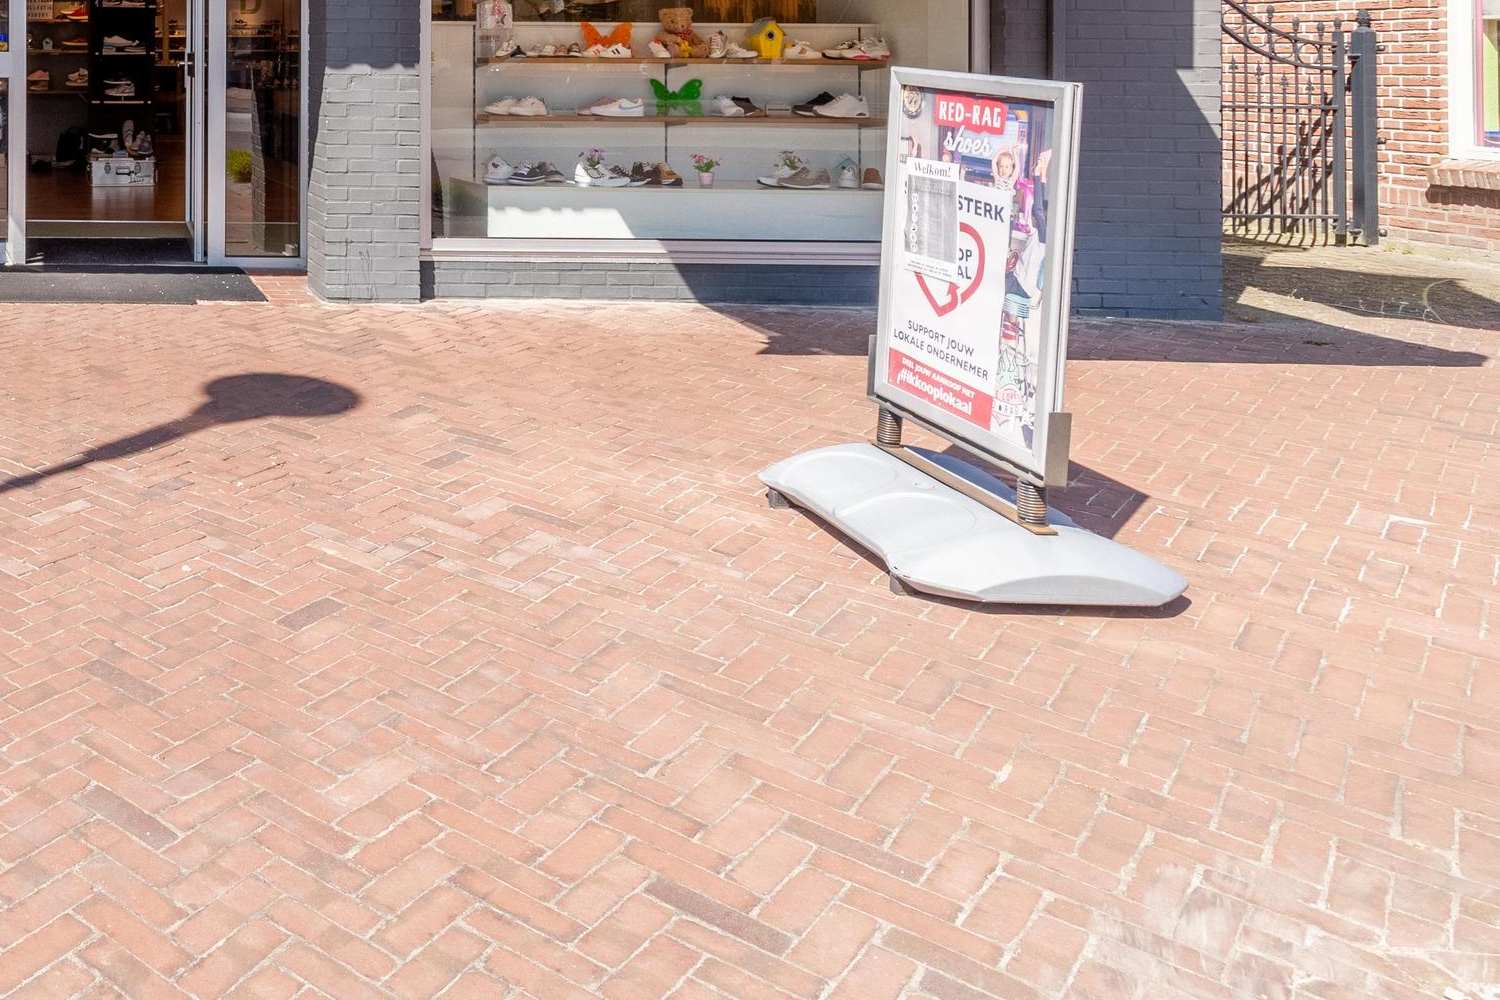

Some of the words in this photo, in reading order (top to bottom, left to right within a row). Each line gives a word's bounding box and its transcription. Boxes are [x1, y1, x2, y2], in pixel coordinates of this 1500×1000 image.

[938, 100, 1002, 129] RED-RAG
[943, 124, 994, 157] shoes
[914, 161, 951, 178] Welkom!
[893, 328, 925, 351] LOKALE
[926, 345, 989, 381] ONDERNEMER
[907, 319, 946, 343] SUPPORT
[946, 337, 975, 357] JOUW
[899, 367, 973, 416] #ikkooplokaal
